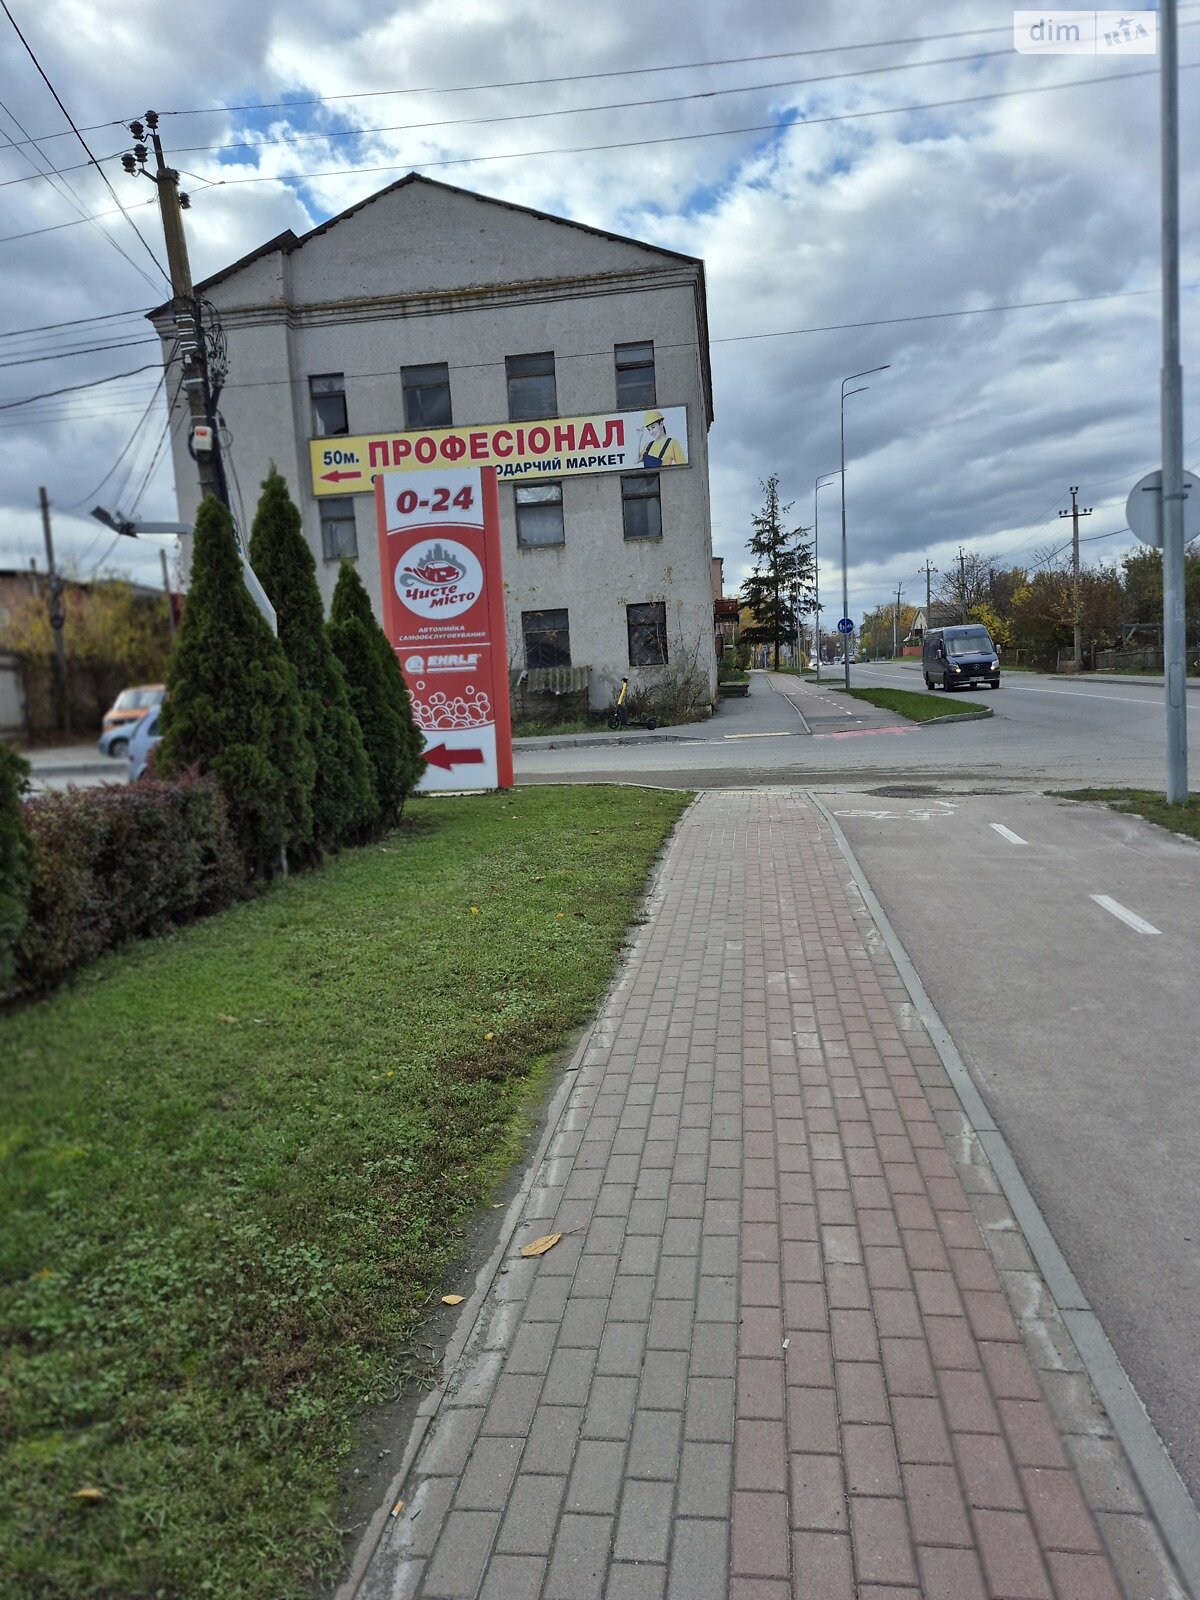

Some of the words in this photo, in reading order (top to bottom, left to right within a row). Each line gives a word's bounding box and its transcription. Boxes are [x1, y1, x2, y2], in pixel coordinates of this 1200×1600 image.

[368, 419, 626, 468] ПРОФЕСІОНАЛ
[323, 450, 360, 466] 50м.
[482, 457, 562, 476] ОДАРЧИЙ
[566, 453, 626, 469] МАРКЕТ
[396, 486, 474, 514] 0-24
[405, 584, 458, 601] Чисте
[429, 591, 476, 609] місто
[418, 624, 465, 633] АВТОМИЙКА
